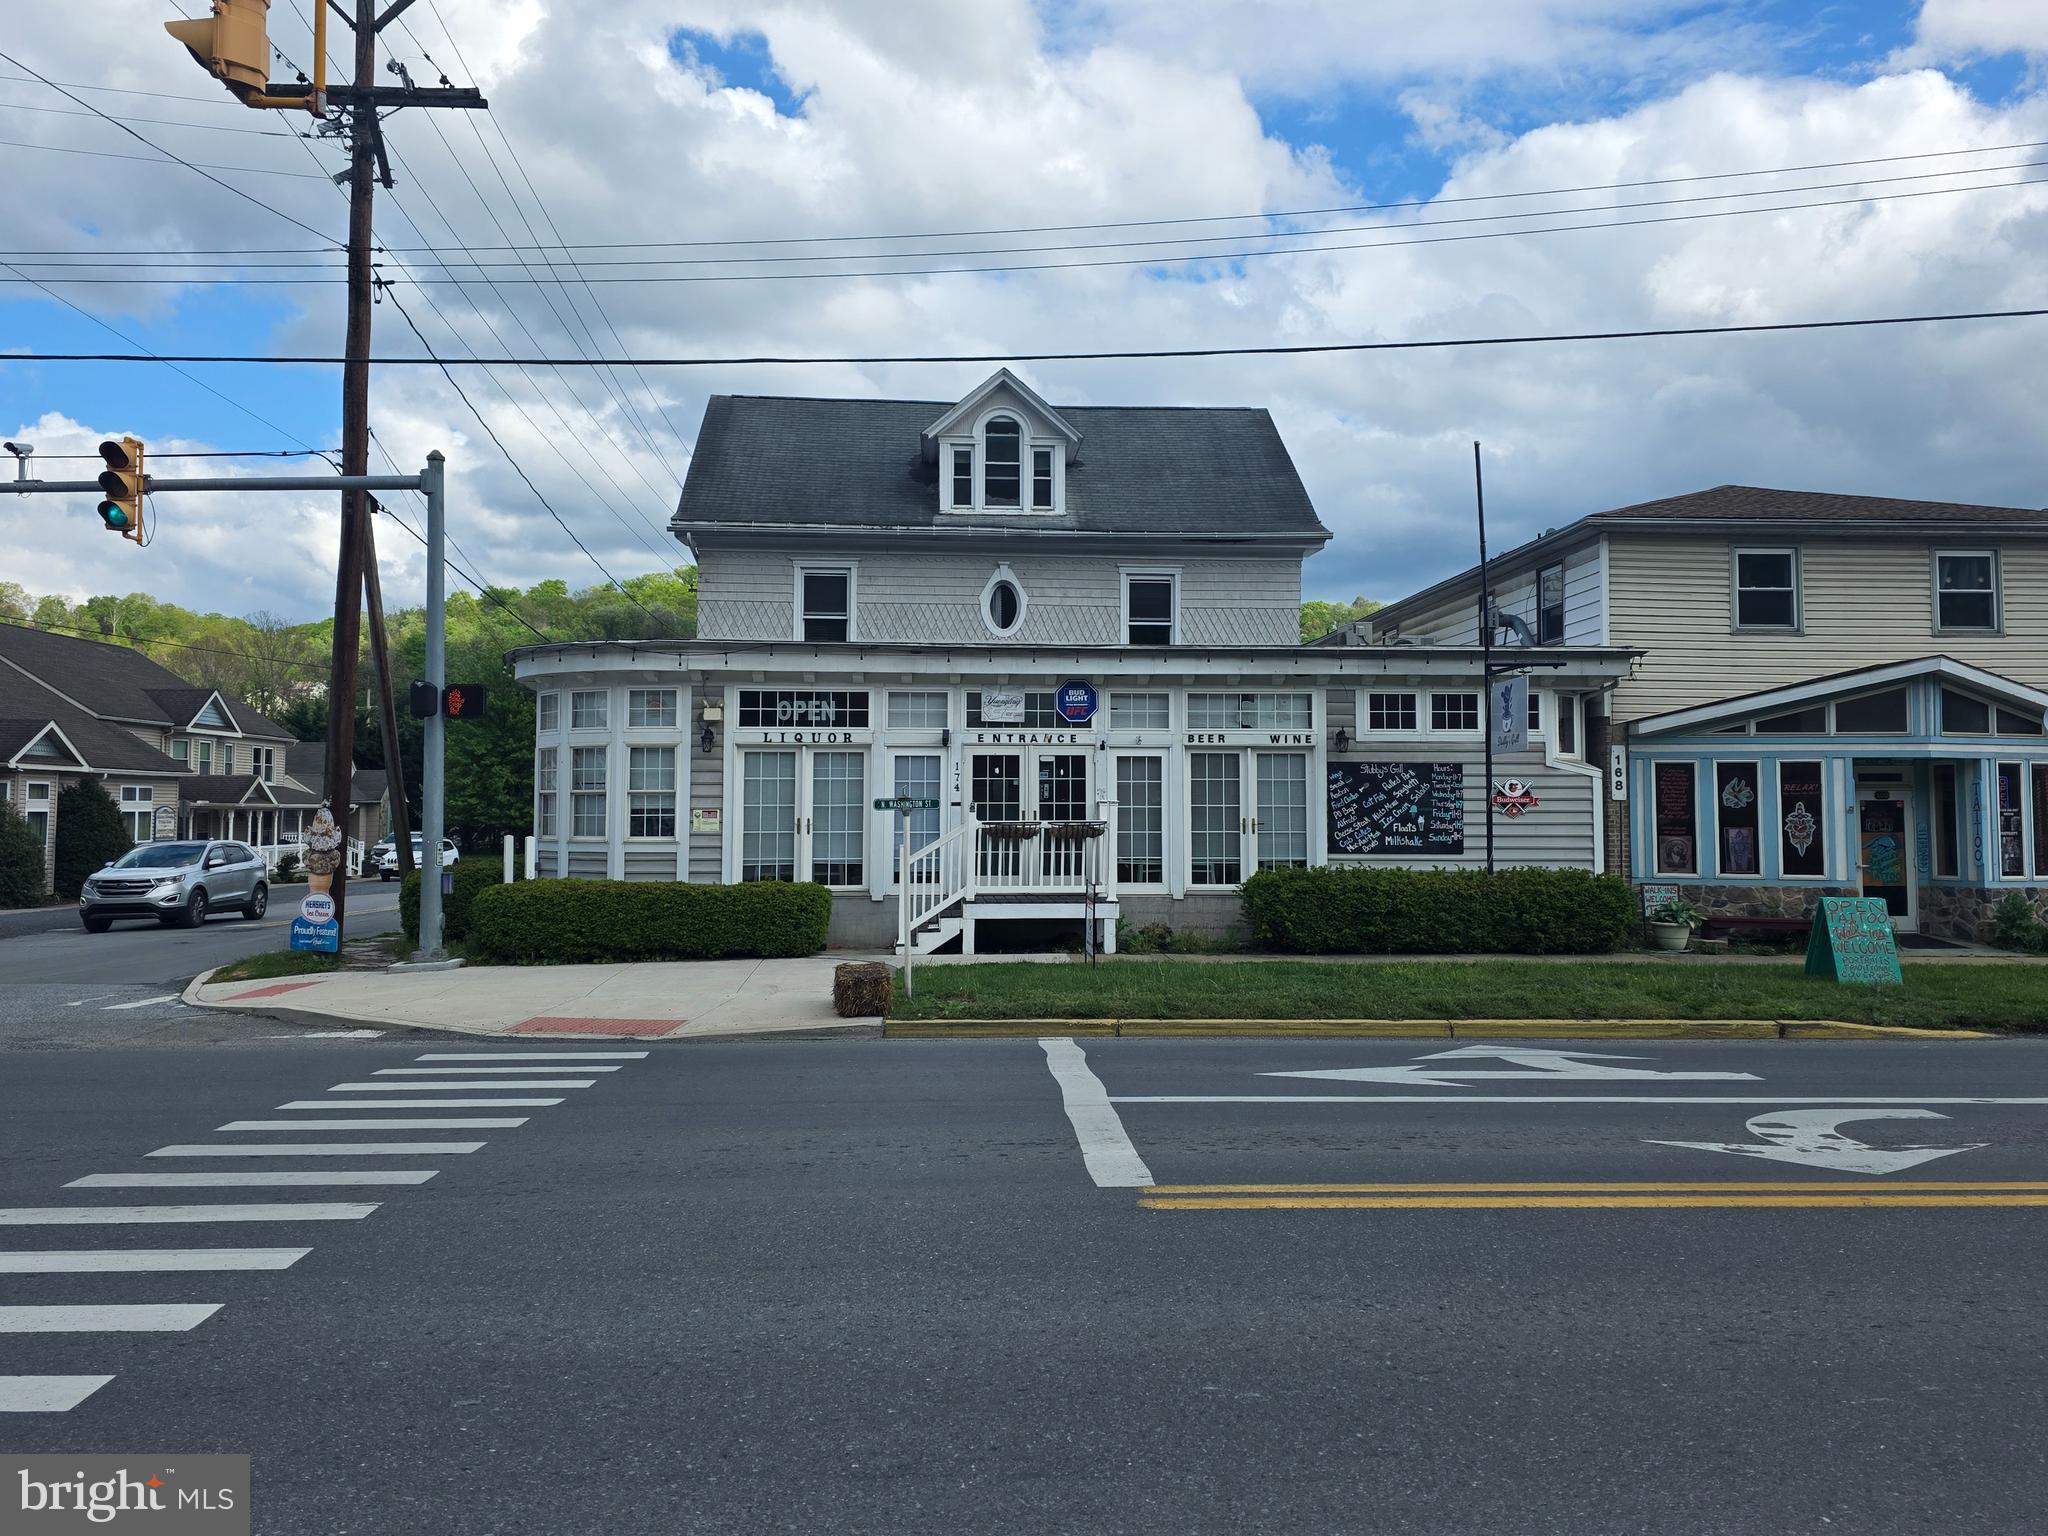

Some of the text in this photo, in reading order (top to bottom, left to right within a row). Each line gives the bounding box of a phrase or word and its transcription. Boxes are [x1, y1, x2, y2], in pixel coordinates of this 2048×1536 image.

[984, 695, 1023, 707] Yuengling
[778, 700, 836, 720] OPEN
[764, 732, 852, 743] LIQUOR
[978, 734, 1077, 743] ENTRANCE
[1188, 734, 1312, 743] BEER WINE
[1360, 764, 1404, 778] Stubby's Grill
[1434, 764, 1453, 772] Hours:
[1614, 754, 1624, 790] 168
[1382, 776, 1401, 791] Pulled
[1373, 792, 1387, 803] Fish
[1410, 783, 1430, 802] Salads
[1379, 802, 1411, 829] Ice Cream
[1393, 822, 1417, 832] Floats
[1972, 783, 1982, 861] TATTOO
[1335, 827, 1354, 840] Cheese
[1827, 901, 1884, 912] OPEN
[1827, 912, 1887, 923] TATTOO
[294, 925, 316, 936] Proudly
[1833, 941, 1895, 954] WELCOME
